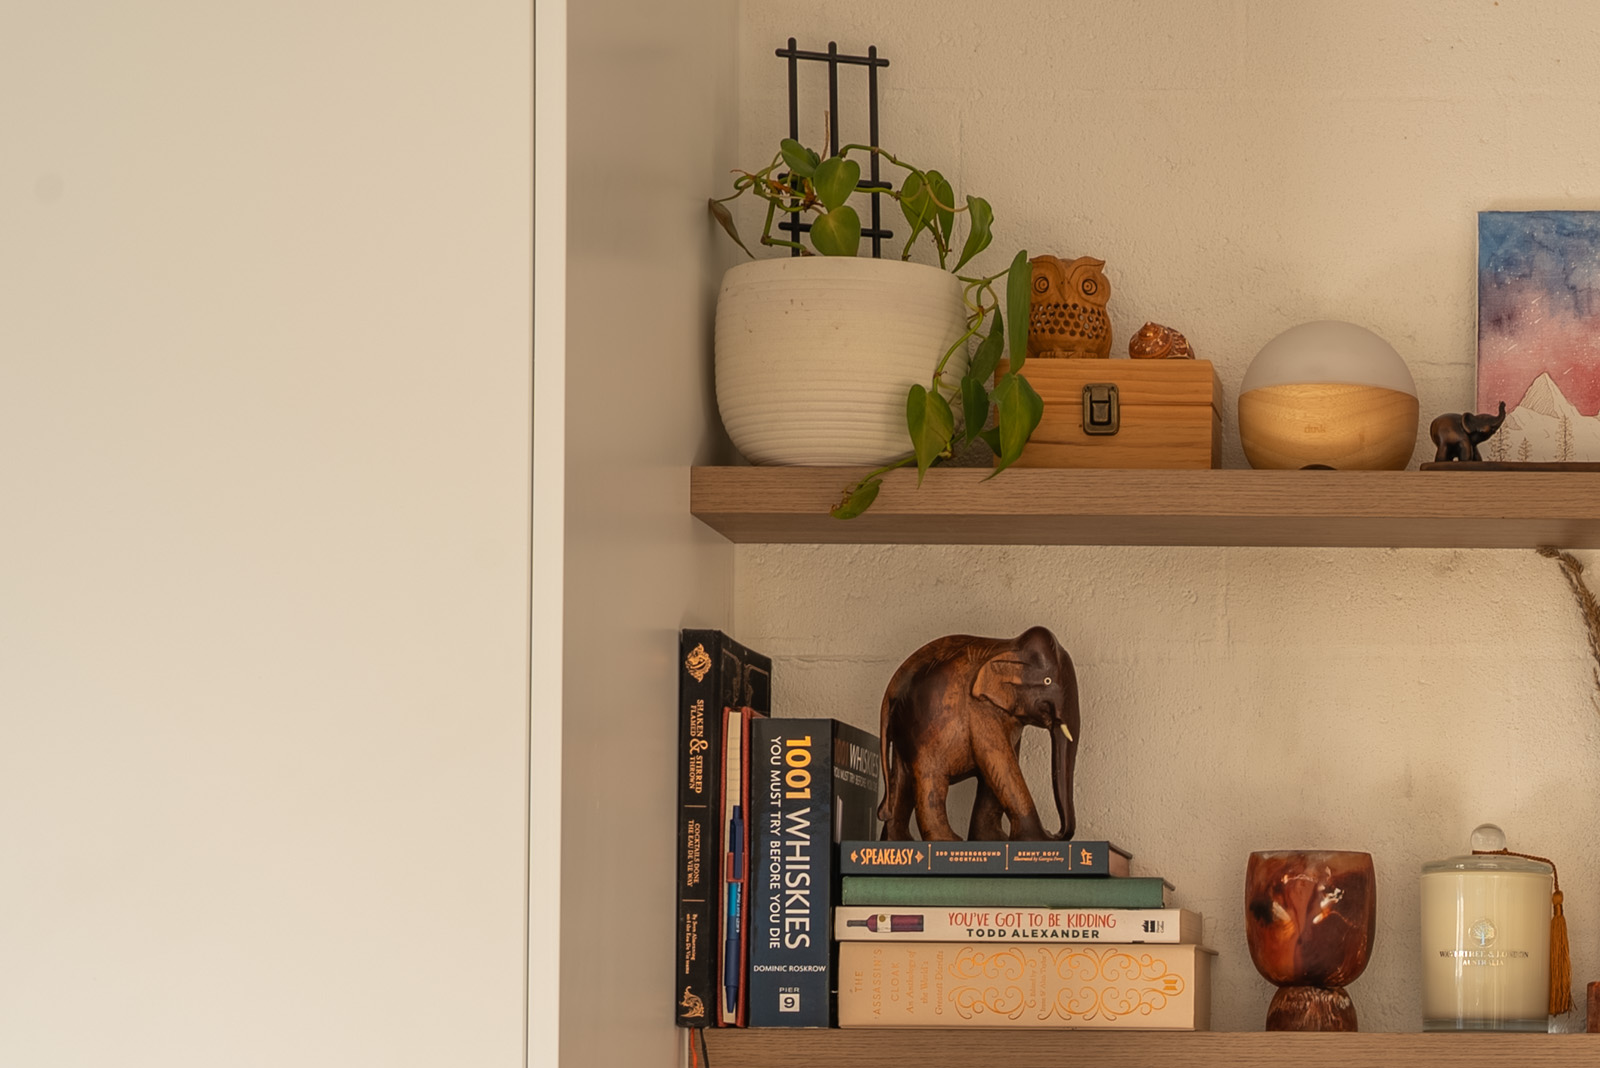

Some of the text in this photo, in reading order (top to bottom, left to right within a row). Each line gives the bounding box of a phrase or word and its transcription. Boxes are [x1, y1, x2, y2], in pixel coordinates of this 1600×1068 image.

[689, 698, 708, 793] SHAKEN & STIRRED
[769, 736, 782, 949] YOU MUST TRY BEFORE YOU DIE
[784, 735, 812, 949] 1001 WHISKIES
[687, 849, 694, 859] DE
[860, 848, 913, 865] SPEAKEASY
[948, 912, 1117, 928] YOU'VE GOT TO BE KIDDING
[966, 929, 1100, 938] TODD ALEXANDER
[753, 965, 827, 973] DOMINIC ROSKROW
[855, 970, 864, 992] THE
[872, 948, 882, 1015] ASSASSIN'S
[890, 962, 900, 1002] CLOAK
[783, 996, 796, 1009] 9
